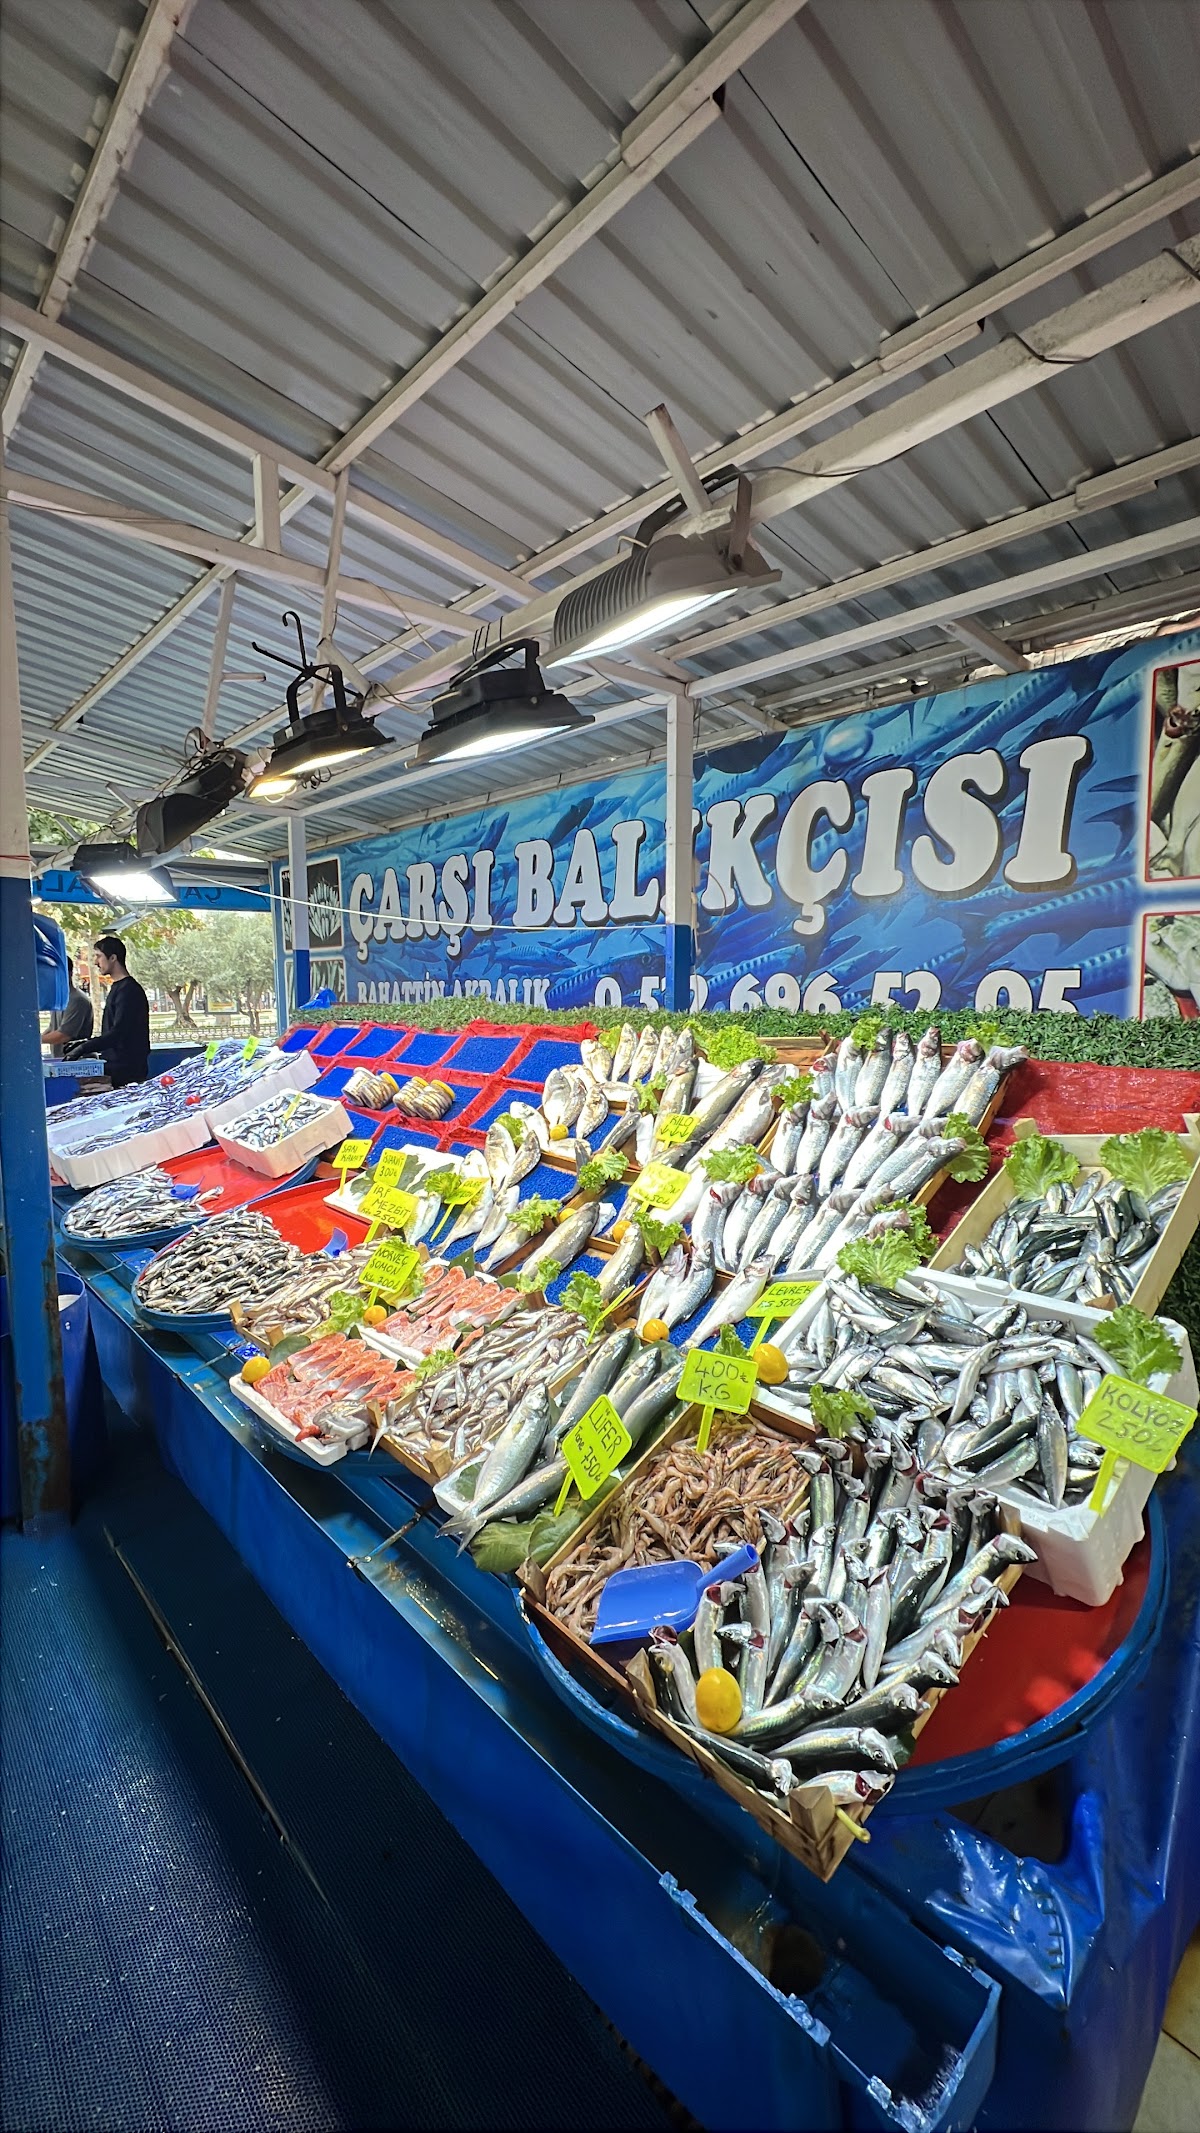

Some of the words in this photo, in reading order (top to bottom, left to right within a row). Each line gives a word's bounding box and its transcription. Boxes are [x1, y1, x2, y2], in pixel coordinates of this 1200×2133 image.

[350, 849, 494, 961] ÇARŞI
[512, 735, 1091, 935] BALKÇISI
[357, 971, 446, 1004] BAHATTİN
[639, 973, 709, 1014] 52
[729, 971, 842, 1014] 696
[870, 969, 942, 1013] 52
[974, 968, 1081, 1014] 05
[589, 1401, 622, 1459] LÜFER
[1101, 1384, 1185, 1437] KOLYOZ
